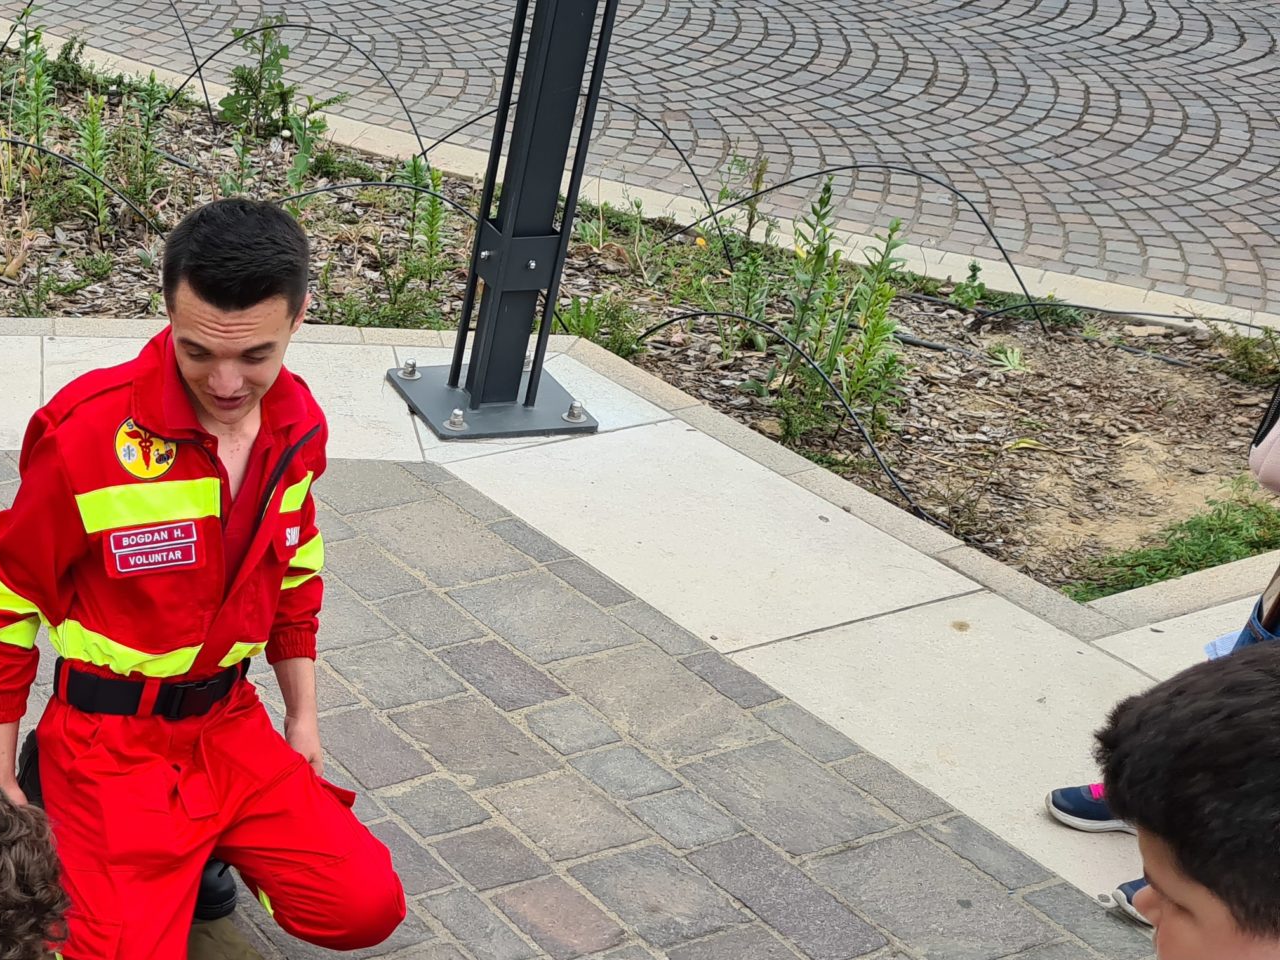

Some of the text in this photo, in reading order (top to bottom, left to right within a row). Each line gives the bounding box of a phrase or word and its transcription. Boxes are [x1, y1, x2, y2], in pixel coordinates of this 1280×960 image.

[122, 528, 185, 546] BOGDAN H.
[128, 550, 182, 566] VOLUNTAR
